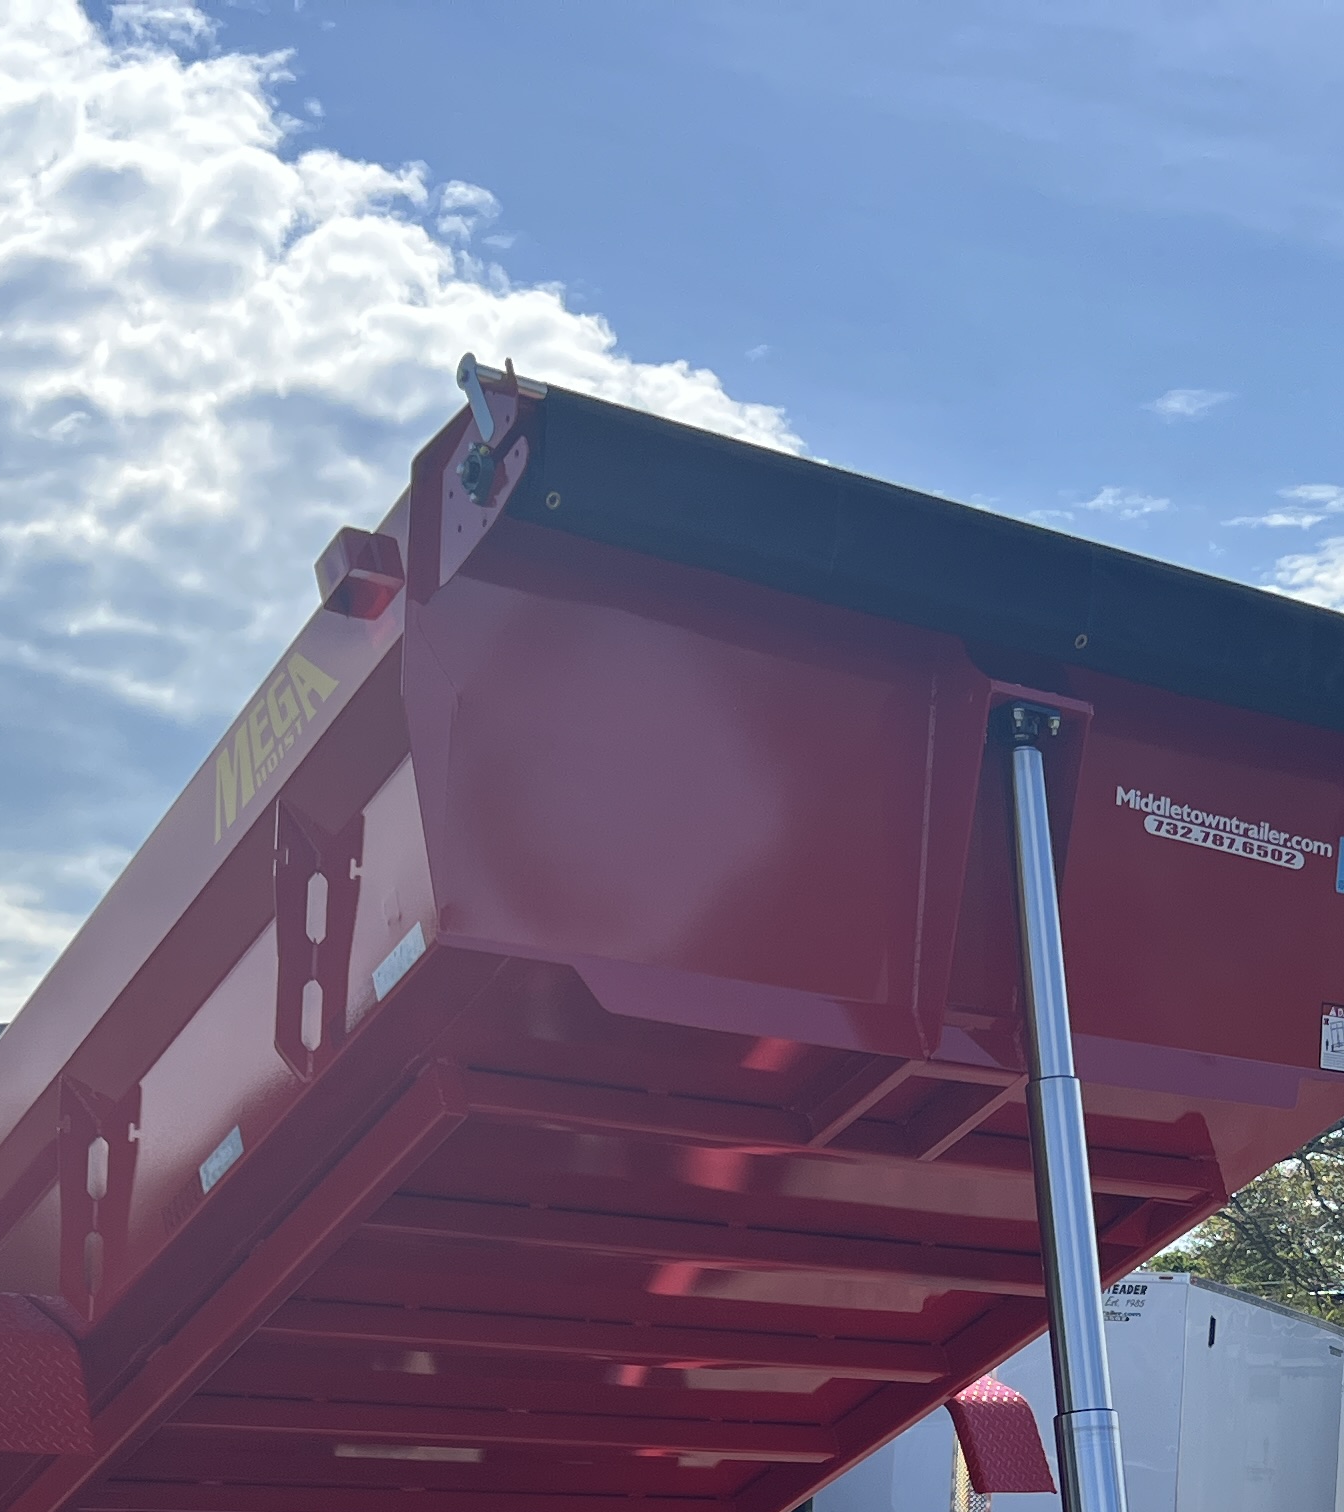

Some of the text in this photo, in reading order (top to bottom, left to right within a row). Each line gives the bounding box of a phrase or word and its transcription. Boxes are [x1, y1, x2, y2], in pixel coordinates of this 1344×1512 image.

[214, 652, 340, 846] MEGA
[1115, 786, 1333, 858] Middletowntrailer.com
[1153, 817, 1297, 866] 732.787.6502
